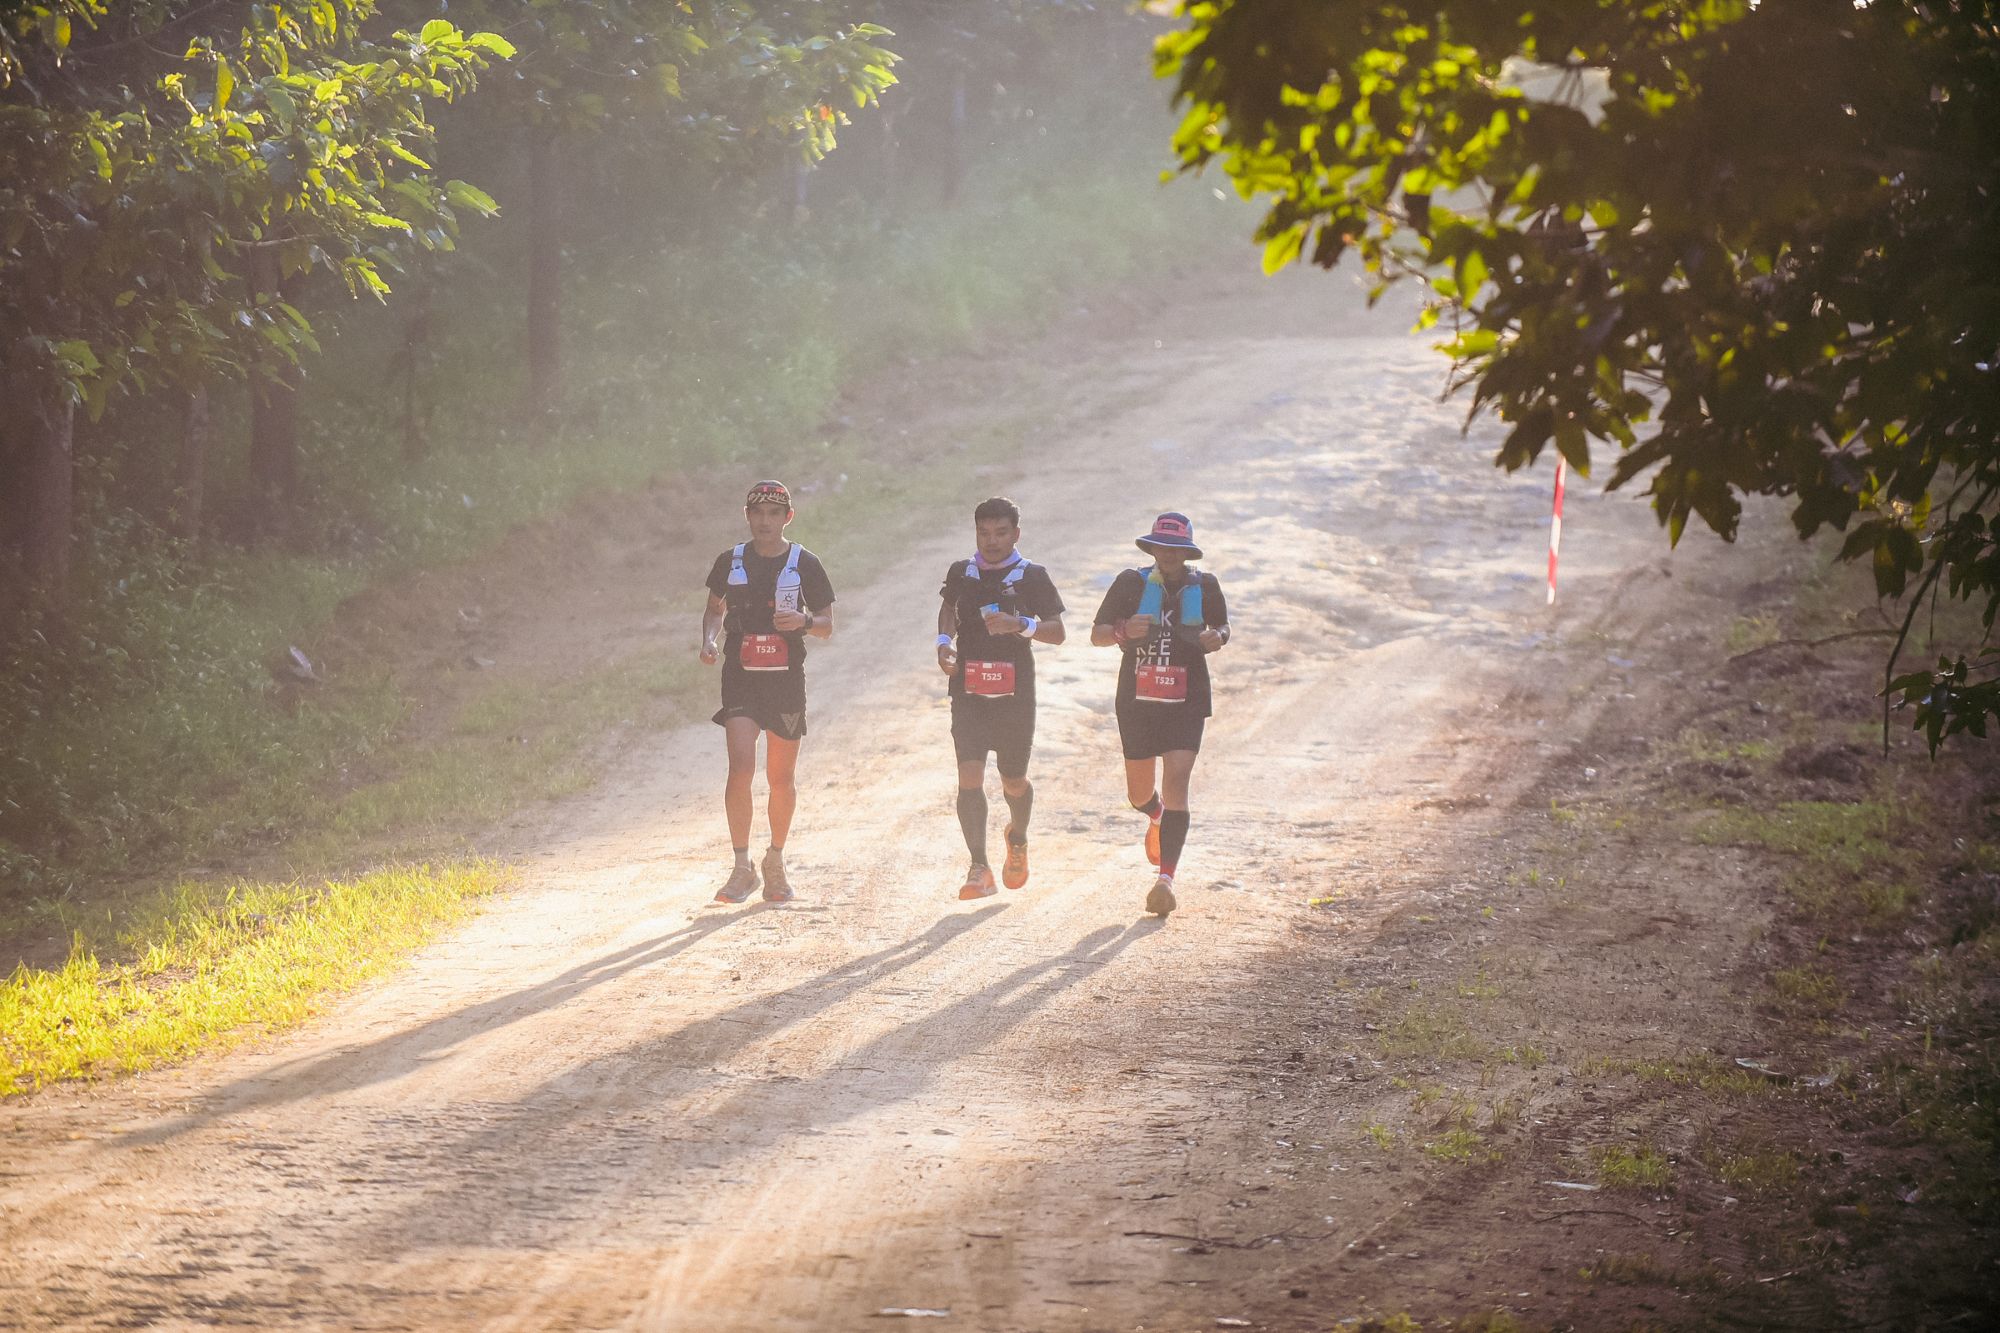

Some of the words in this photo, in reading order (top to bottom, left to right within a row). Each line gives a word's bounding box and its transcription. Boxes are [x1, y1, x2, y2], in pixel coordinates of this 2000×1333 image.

[755, 645, 777, 654] T525
[981, 672, 1003, 681] T525
[1155, 676, 1175, 685] T525
